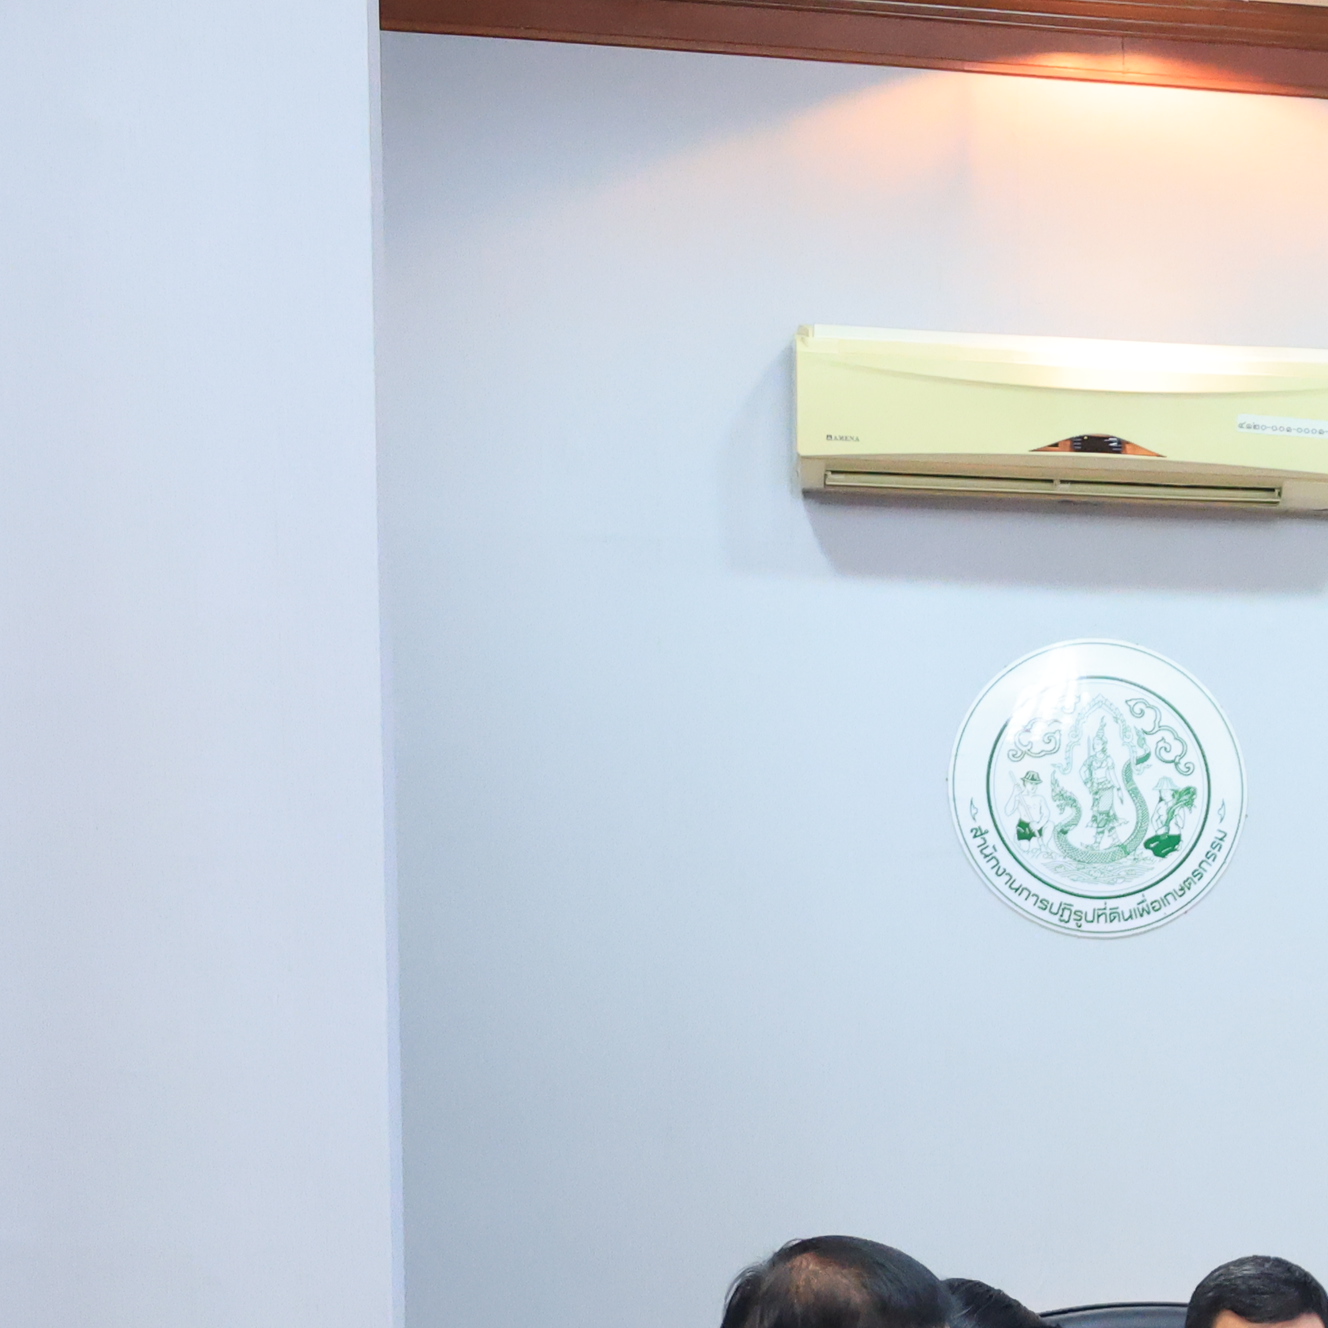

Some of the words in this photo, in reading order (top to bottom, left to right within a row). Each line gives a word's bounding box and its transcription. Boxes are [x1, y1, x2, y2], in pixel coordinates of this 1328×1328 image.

[970, 826, 1227, 928] สำนักงานการปฏิรูปที่ดินเพื่อเกษตรกรรม
